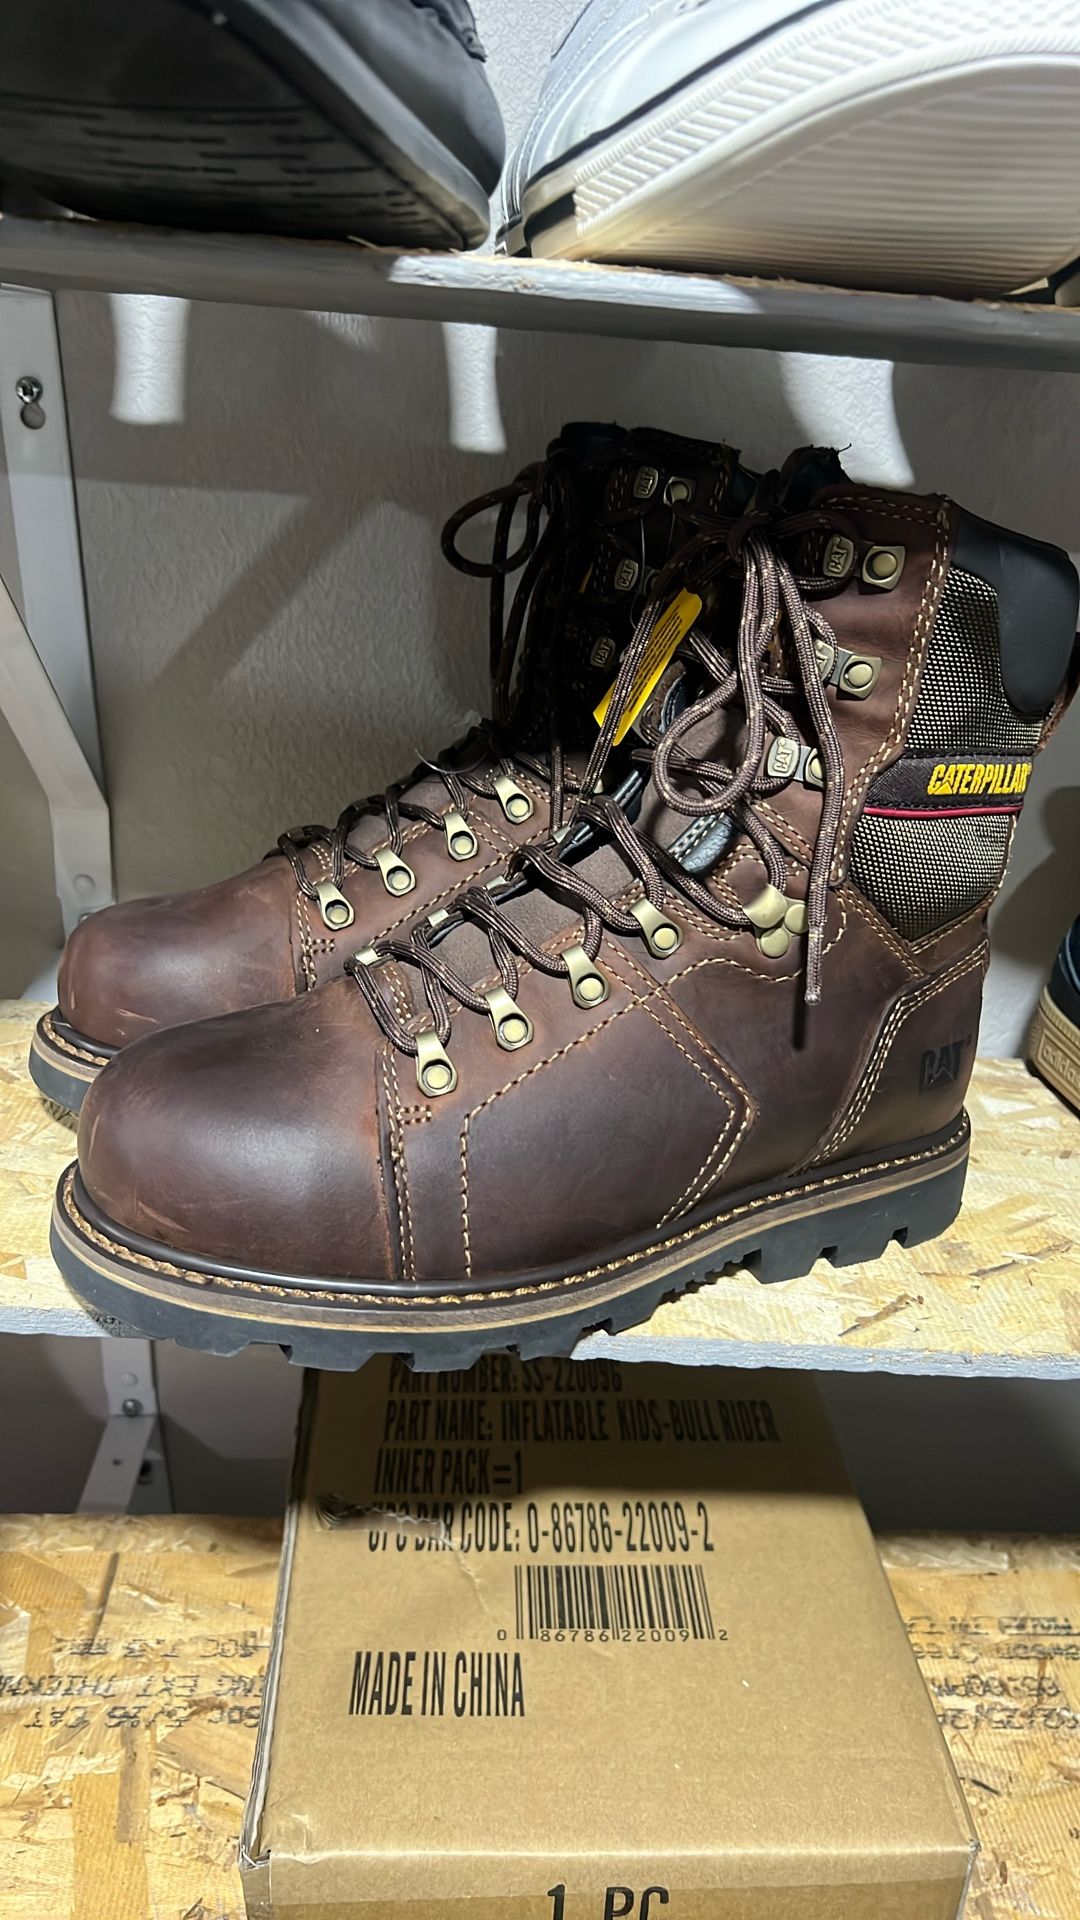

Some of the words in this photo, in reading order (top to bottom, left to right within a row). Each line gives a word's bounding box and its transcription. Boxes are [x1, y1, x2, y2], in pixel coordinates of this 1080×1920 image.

[617, 560, 635, 588] CAT
[826, 543, 849, 576] CAT
[772, 747, 795, 774] CAT
[926, 763, 1029, 796] CATERPILLAR
[384, 1400, 430, 1442] PART
[434, 1400, 494, 1442] NAME:
[502, 1400, 609, 1442] INFLATABLE
[616, 1400, 718, 1442] KIDS-BULL
[719, 1400, 781, 1442] RIDER
[374, 1448, 435, 1494] INNER
[460, 1502, 520, 1552] CODE:
[528, 1502, 715, 1552] 0-86786-22009-2
[497, 1629, 507, 1641] 0
[540, 1629, 610, 1643] 86786
[622, 1629, 690, 1643] 22009
[719, 1629, 729, 1642] 2
[349, 1651, 417, 1715] MADE
[421, 1651, 446, 1715] IN
[453, 1651, 525, 1717] CHINA
